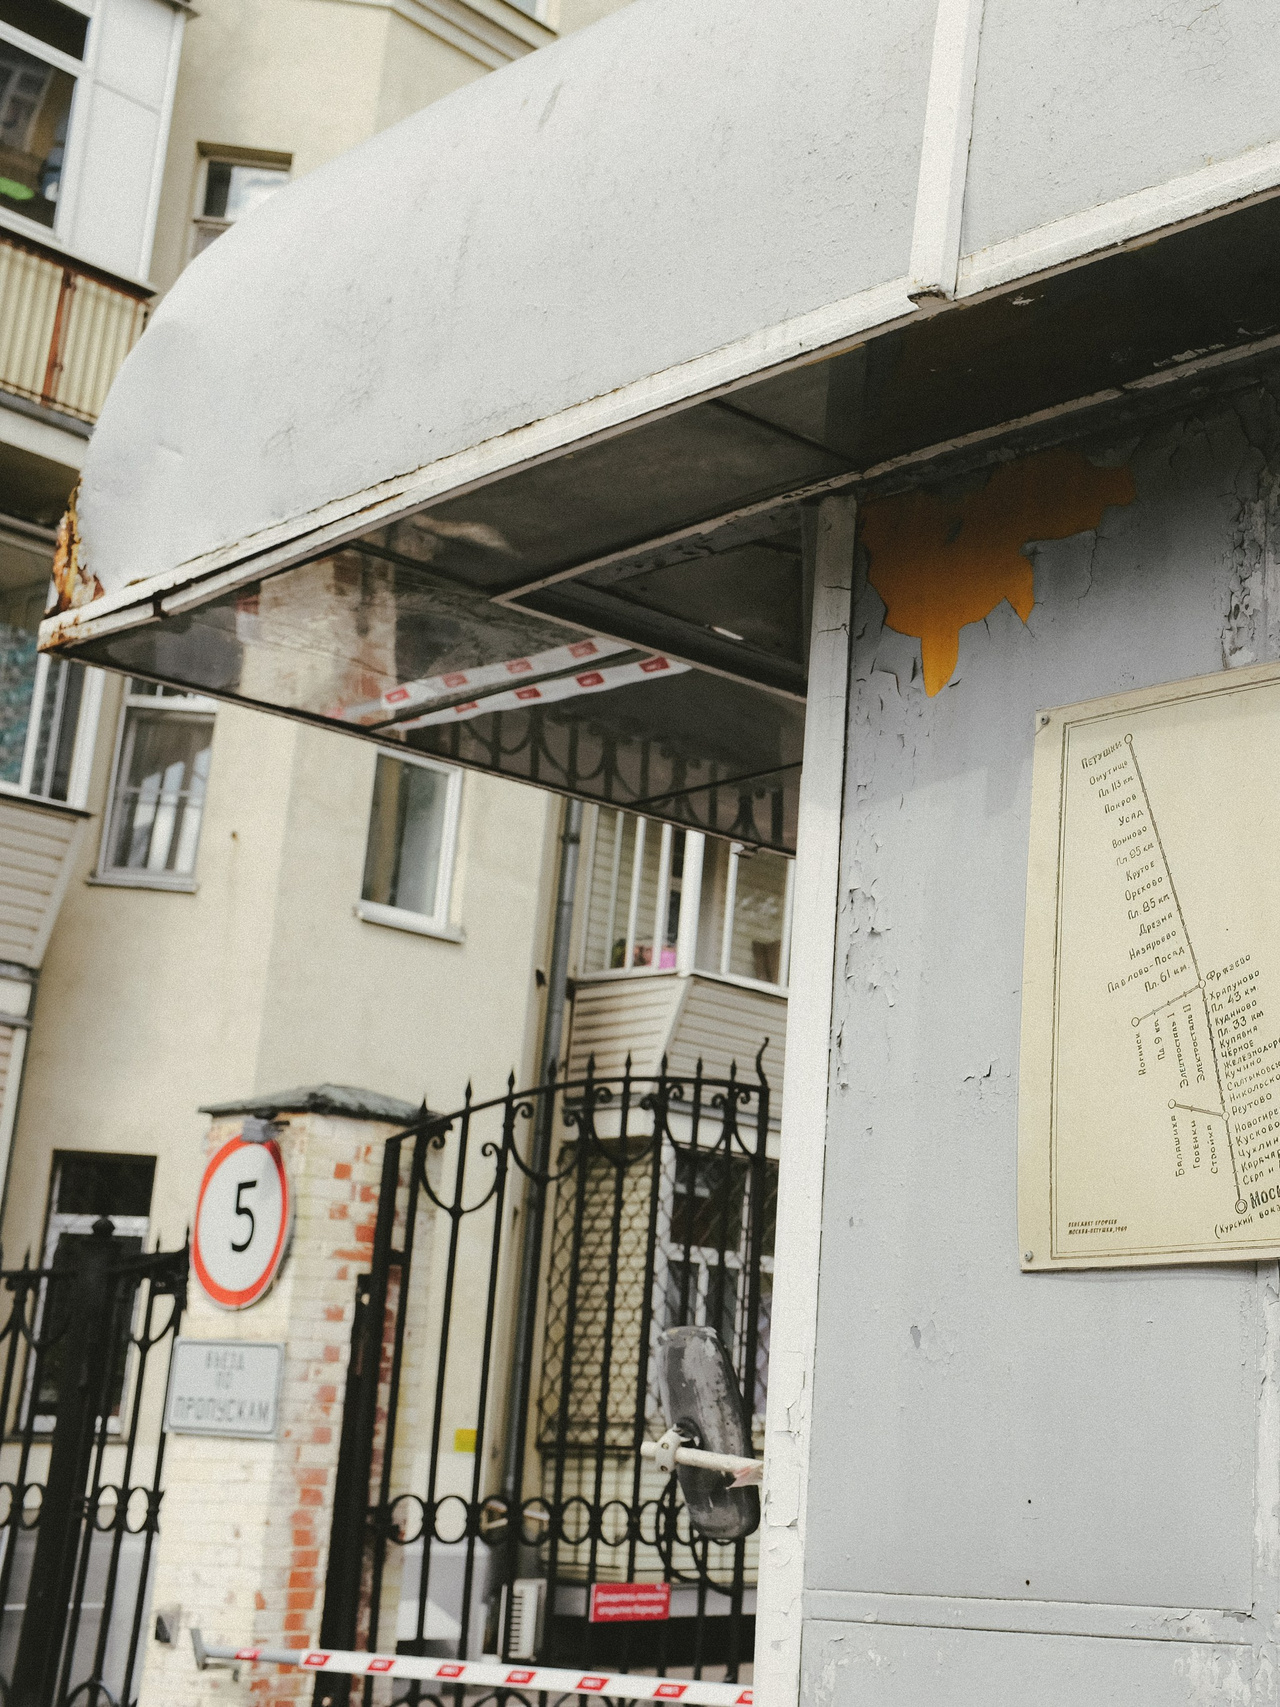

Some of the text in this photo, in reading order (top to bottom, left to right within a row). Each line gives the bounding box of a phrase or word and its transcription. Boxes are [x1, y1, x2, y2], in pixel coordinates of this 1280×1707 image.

[1089, 760, 1128, 785] Омутище
[1104, 793, 1137, 814] Покров
[1138, 912, 1173, 937] Дрезна
[1159, 969, 1171, 983] 61
[1227, 991, 1242, 1003] 43
[1232, 1016, 1248, 1030] 33
[1231, 1092, 1272, 1116] Реутово
[1235, 1121, 1280, 1146] Кусково
[231, 1180, 257, 1252] 5
